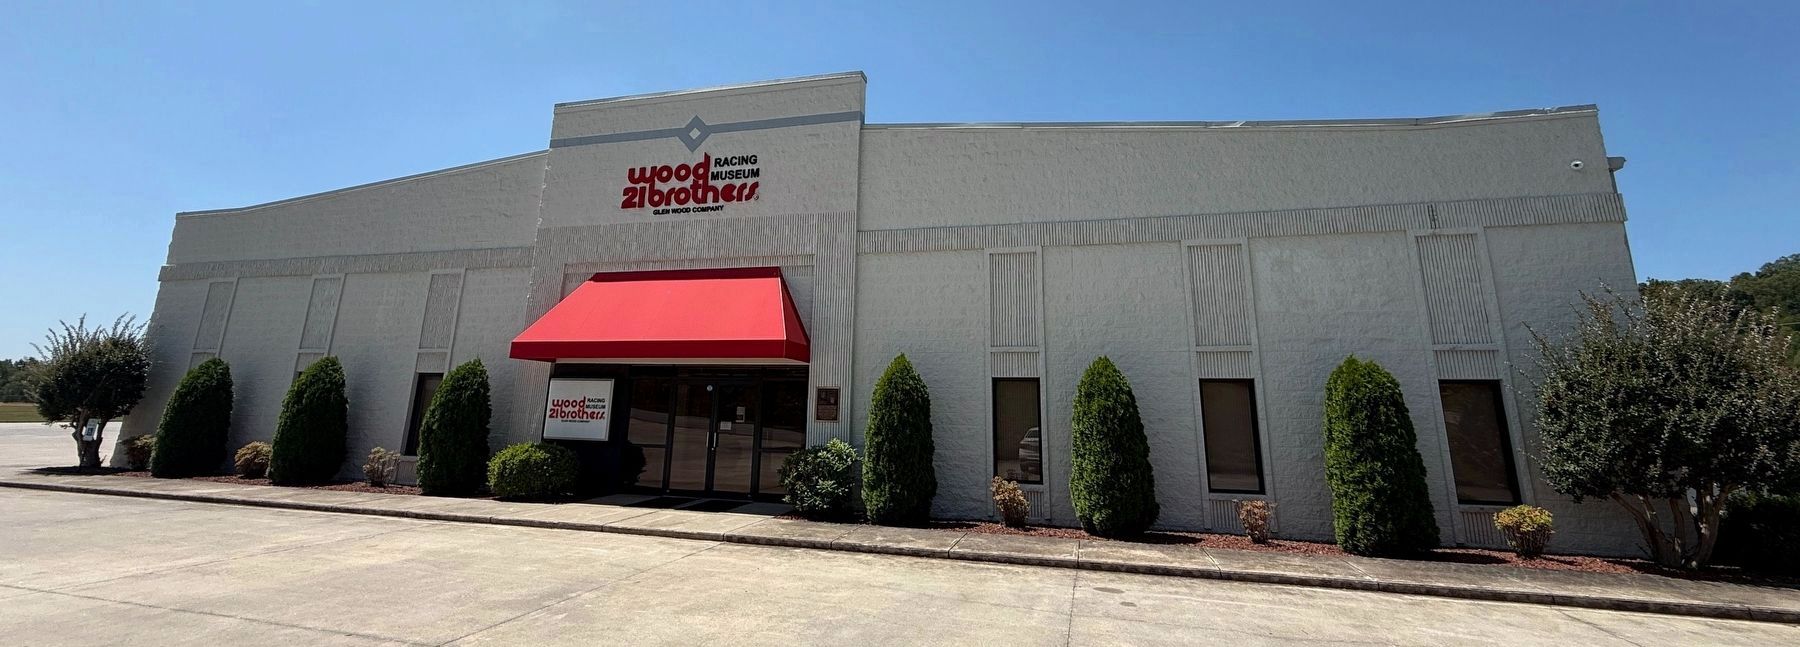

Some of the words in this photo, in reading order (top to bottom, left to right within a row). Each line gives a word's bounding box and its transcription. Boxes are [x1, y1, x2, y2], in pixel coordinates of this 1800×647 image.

[714, 154, 758, 168] RACING
[628, 152, 711, 184] wood
[710, 168, 760, 181] MUSEUM
[671, 206, 691, 215] WOOD
[692, 205, 724, 213] COMPANY
[552, 396, 586, 408] wood
